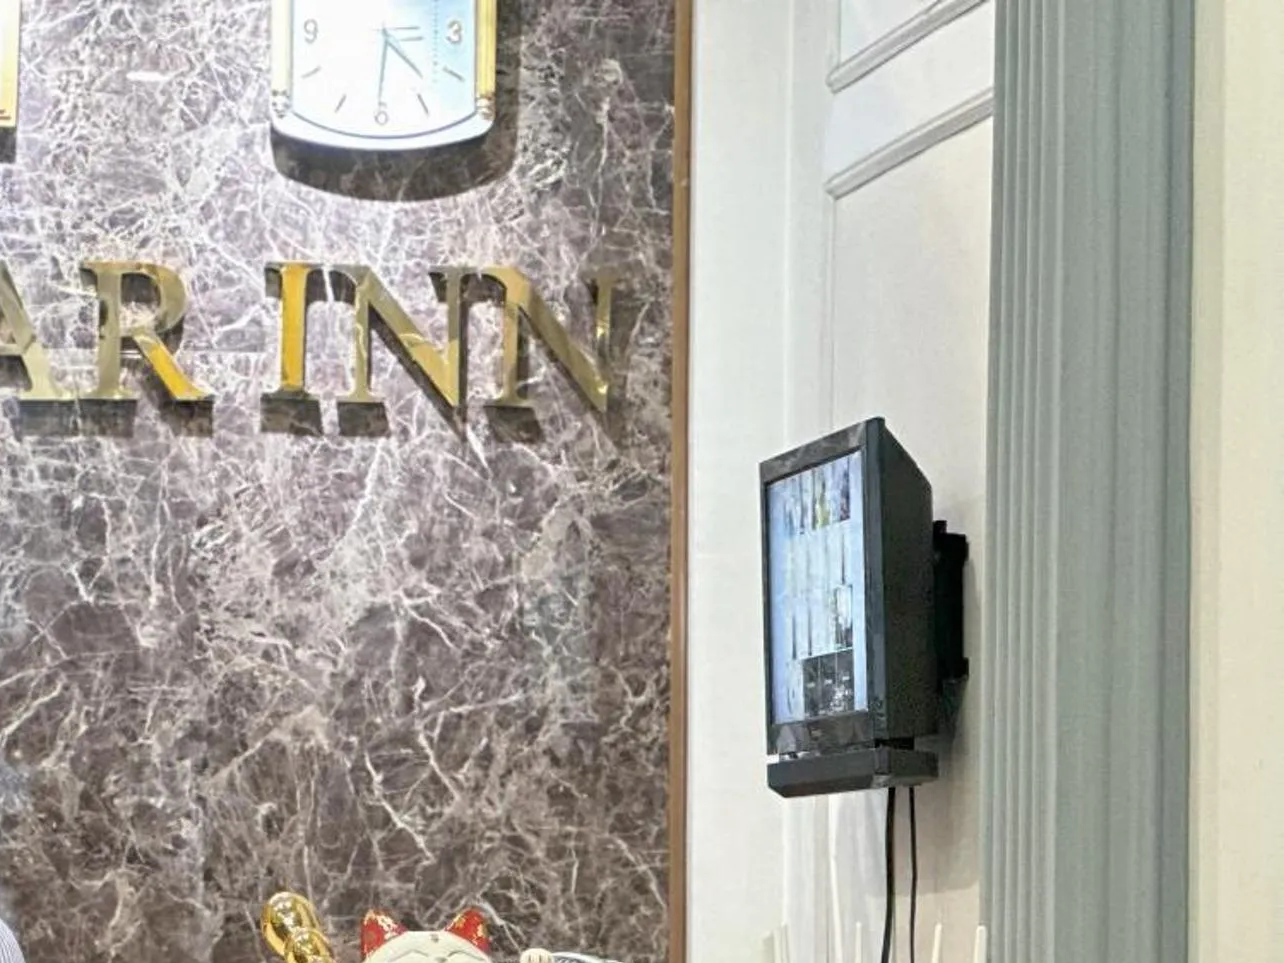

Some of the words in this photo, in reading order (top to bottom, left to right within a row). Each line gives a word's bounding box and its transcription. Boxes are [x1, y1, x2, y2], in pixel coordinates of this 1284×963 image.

[303, 19, 318, 44] 9
[446, 20, 462, 45] 3
[265, 261, 626, 408] INN
